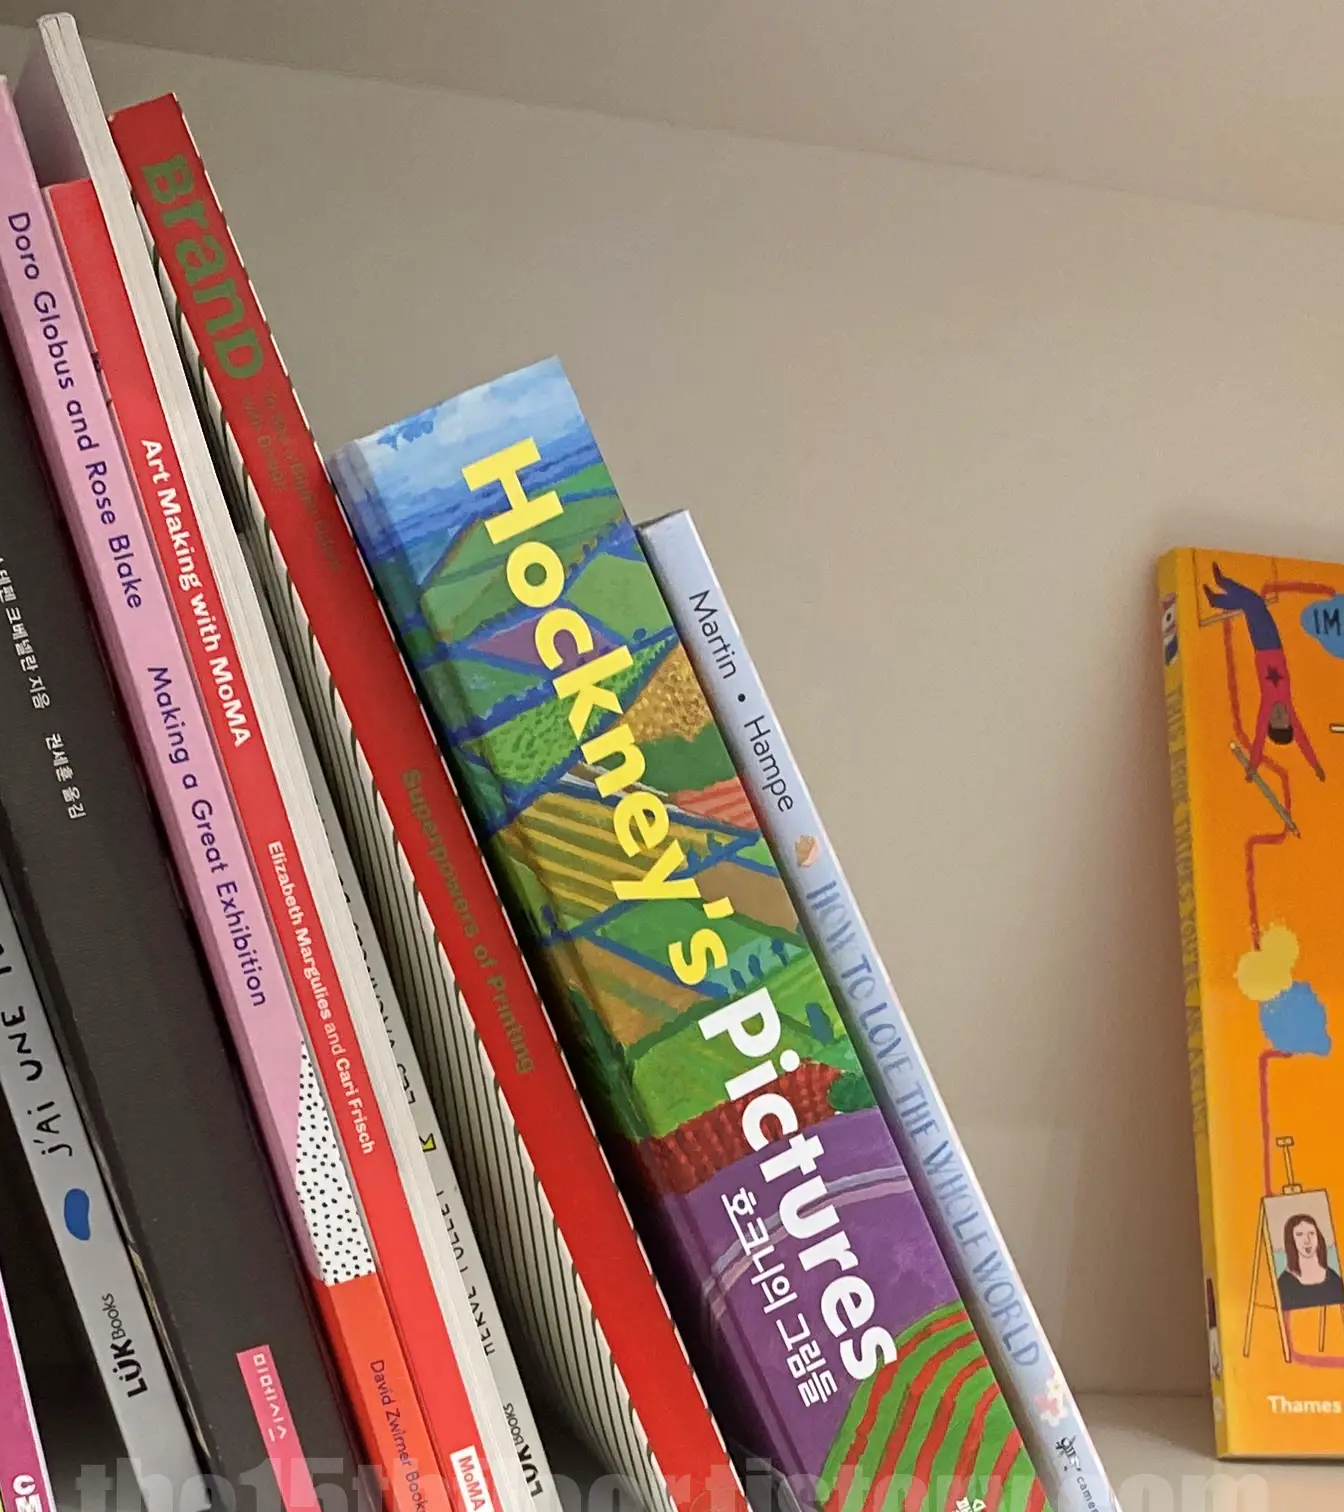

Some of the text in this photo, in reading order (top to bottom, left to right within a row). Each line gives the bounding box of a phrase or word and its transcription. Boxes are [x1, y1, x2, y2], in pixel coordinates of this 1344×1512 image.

[8, 212, 141, 609] Doro Globus and Rose Blake
[141, 440, 251, 748] Art Making with MoMA
[688, 589, 794, 812] Martin Hampe
[147, 667, 267, 1007] Making Great Exhibition
[461, 436, 898, 1381] Hockney's Pictures
[268, 841, 375, 1156] Elizabeth Margulies and Cari Frisch
[806, 878, 1042, 1369] HOW TO LOVE THE WHOLE WORLD
[253, 1353, 287, 1442] 미메시스
[721, 1187, 838, 1408] 호크니의 그림들
[1268, 1396, 1340, 1414] Thames
